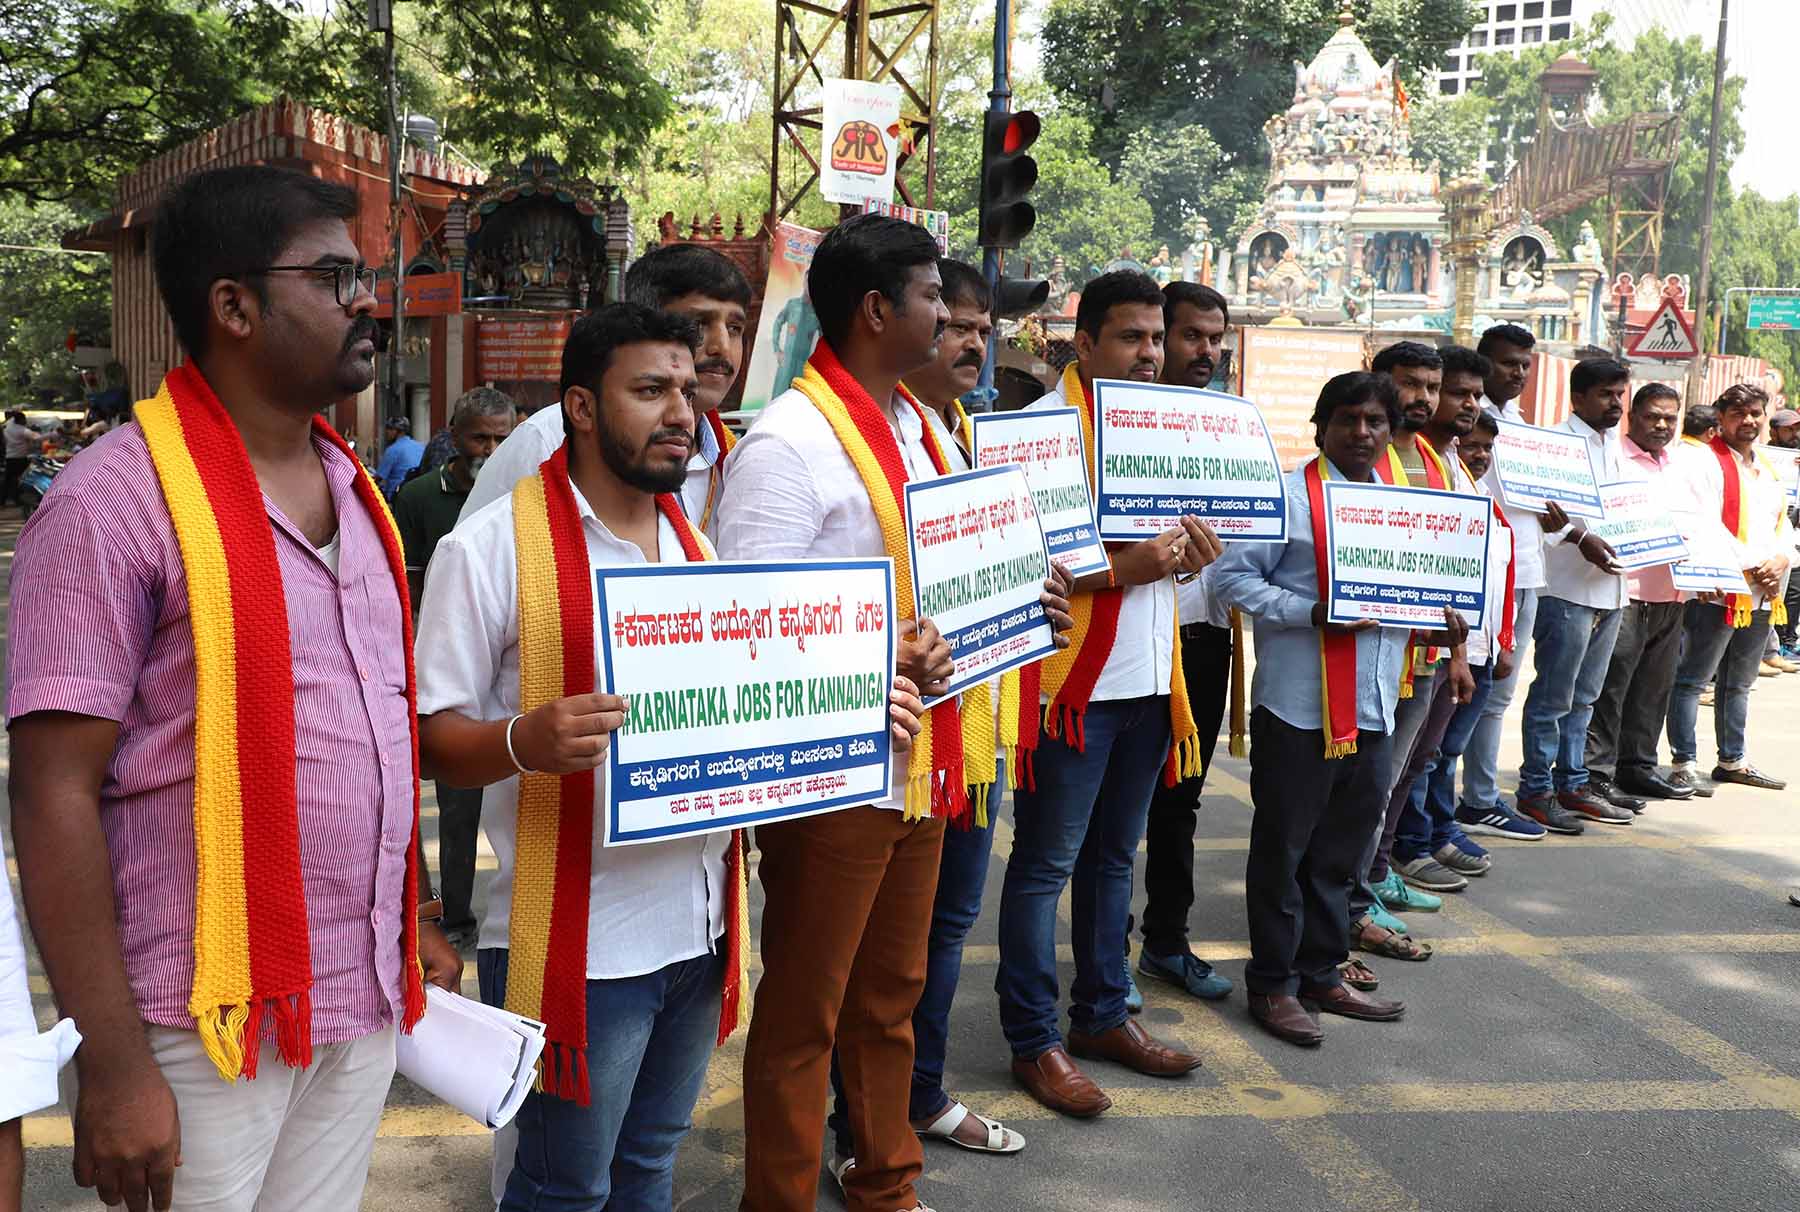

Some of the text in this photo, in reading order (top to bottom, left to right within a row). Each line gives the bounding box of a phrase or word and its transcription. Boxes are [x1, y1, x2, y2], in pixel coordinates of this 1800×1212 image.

[1105, 453, 1278, 483] #KARNATAKA JOBS FOR KANNADIGA
[1038, 483, 1088, 515] FOR KANNADIGA
[922, 550, 1046, 618] #KARNATAKA JOBS FOR KANNADIGA
[1337, 545, 1481, 580] #KARNATAKA JOBS FOR KANNADIGA
[614, 594, 884, 661] #ಕರ್ನಾಟಕದ ಉದ್ಯೋಗ ಕನ್ನಡಿಗರಿಗೆ ಸಿಗಲಿ
[622, 671, 884, 736] #KARNATAKA JOBS FOR KANNADIGA
[630, 738, 877, 791] ಕನ್ನಡಿಗರಿಗೆ ಉದ್ಯೋಗದಲ್ಲಿ ಮೀಸಲಾತಿ ಕೊಡಿ.
[670, 797, 689, 814] ಇದು
[694, 793, 715, 815] ನಮ್ಮ
[719, 789, 744, 807] ಮನವಿ
[767, 780, 802, 803] ಕನ್ನಡಿಗರ
